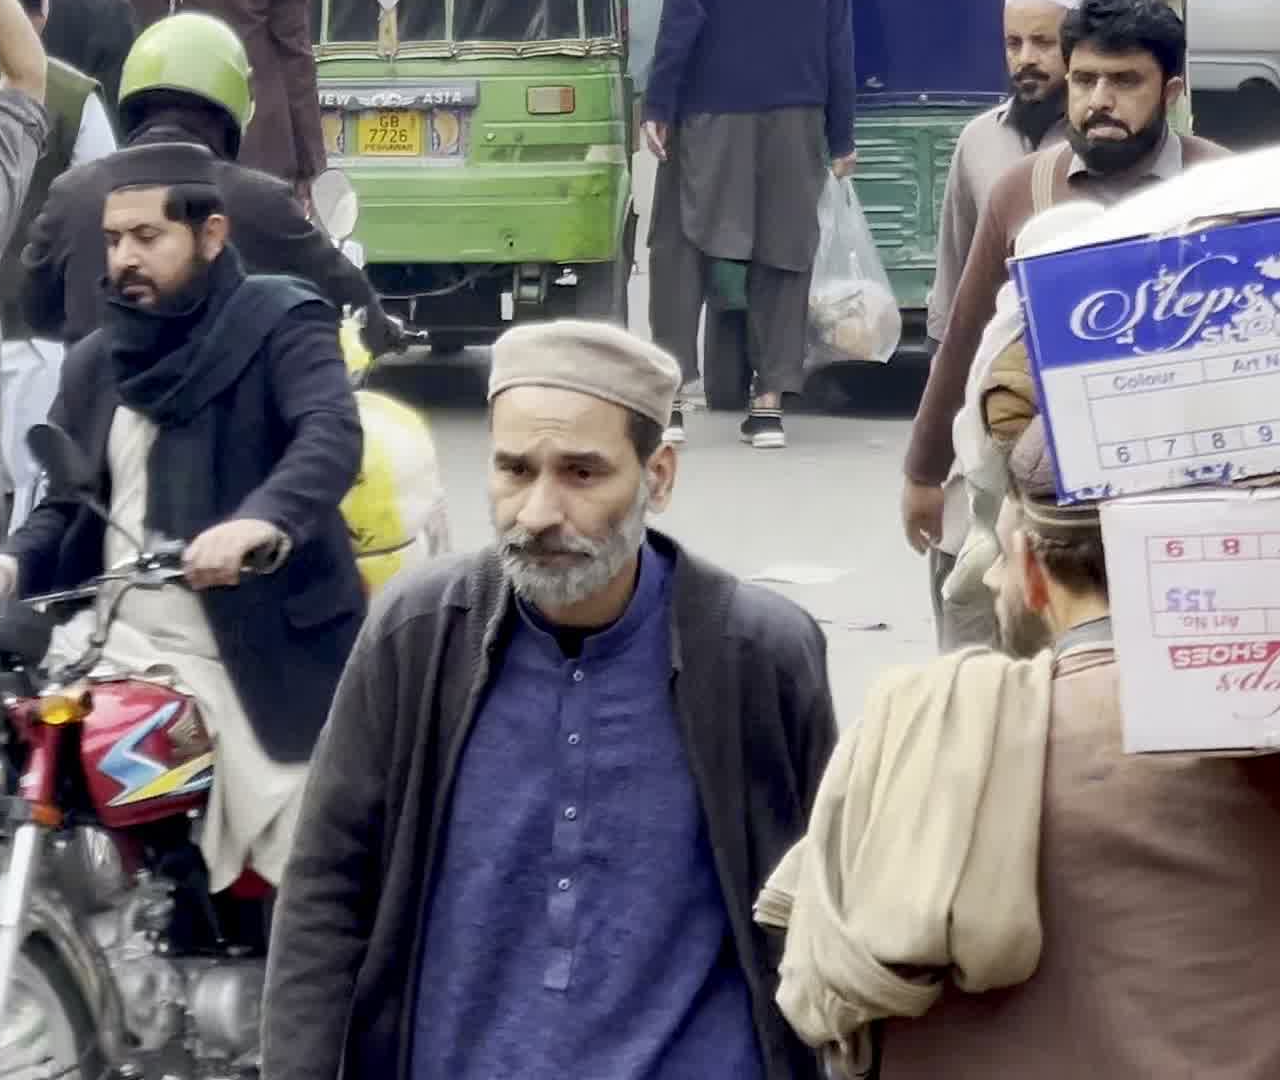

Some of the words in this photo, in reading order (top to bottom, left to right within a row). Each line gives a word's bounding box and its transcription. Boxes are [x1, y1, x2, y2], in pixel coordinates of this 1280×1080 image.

[422, 91, 463, 105] ASIA
[379, 115, 400, 128] GB
[368, 128, 409, 142] 7726
[1069, 254, 1266, 354] Steps
[1112, 370, 1177, 391] Colour
[1232, 356, 1261, 374] Art
[1116, 445, 1132, 465] 6
[1166, 439, 1178, 458] 7
[1211, 432, 1226, 450] 8
[1257, 424, 1274, 443] 9
[1222, 537, 1241, 555] 8
[1214, 614, 1240, 629] Art
[1172, 641, 1269, 668] SHOES
